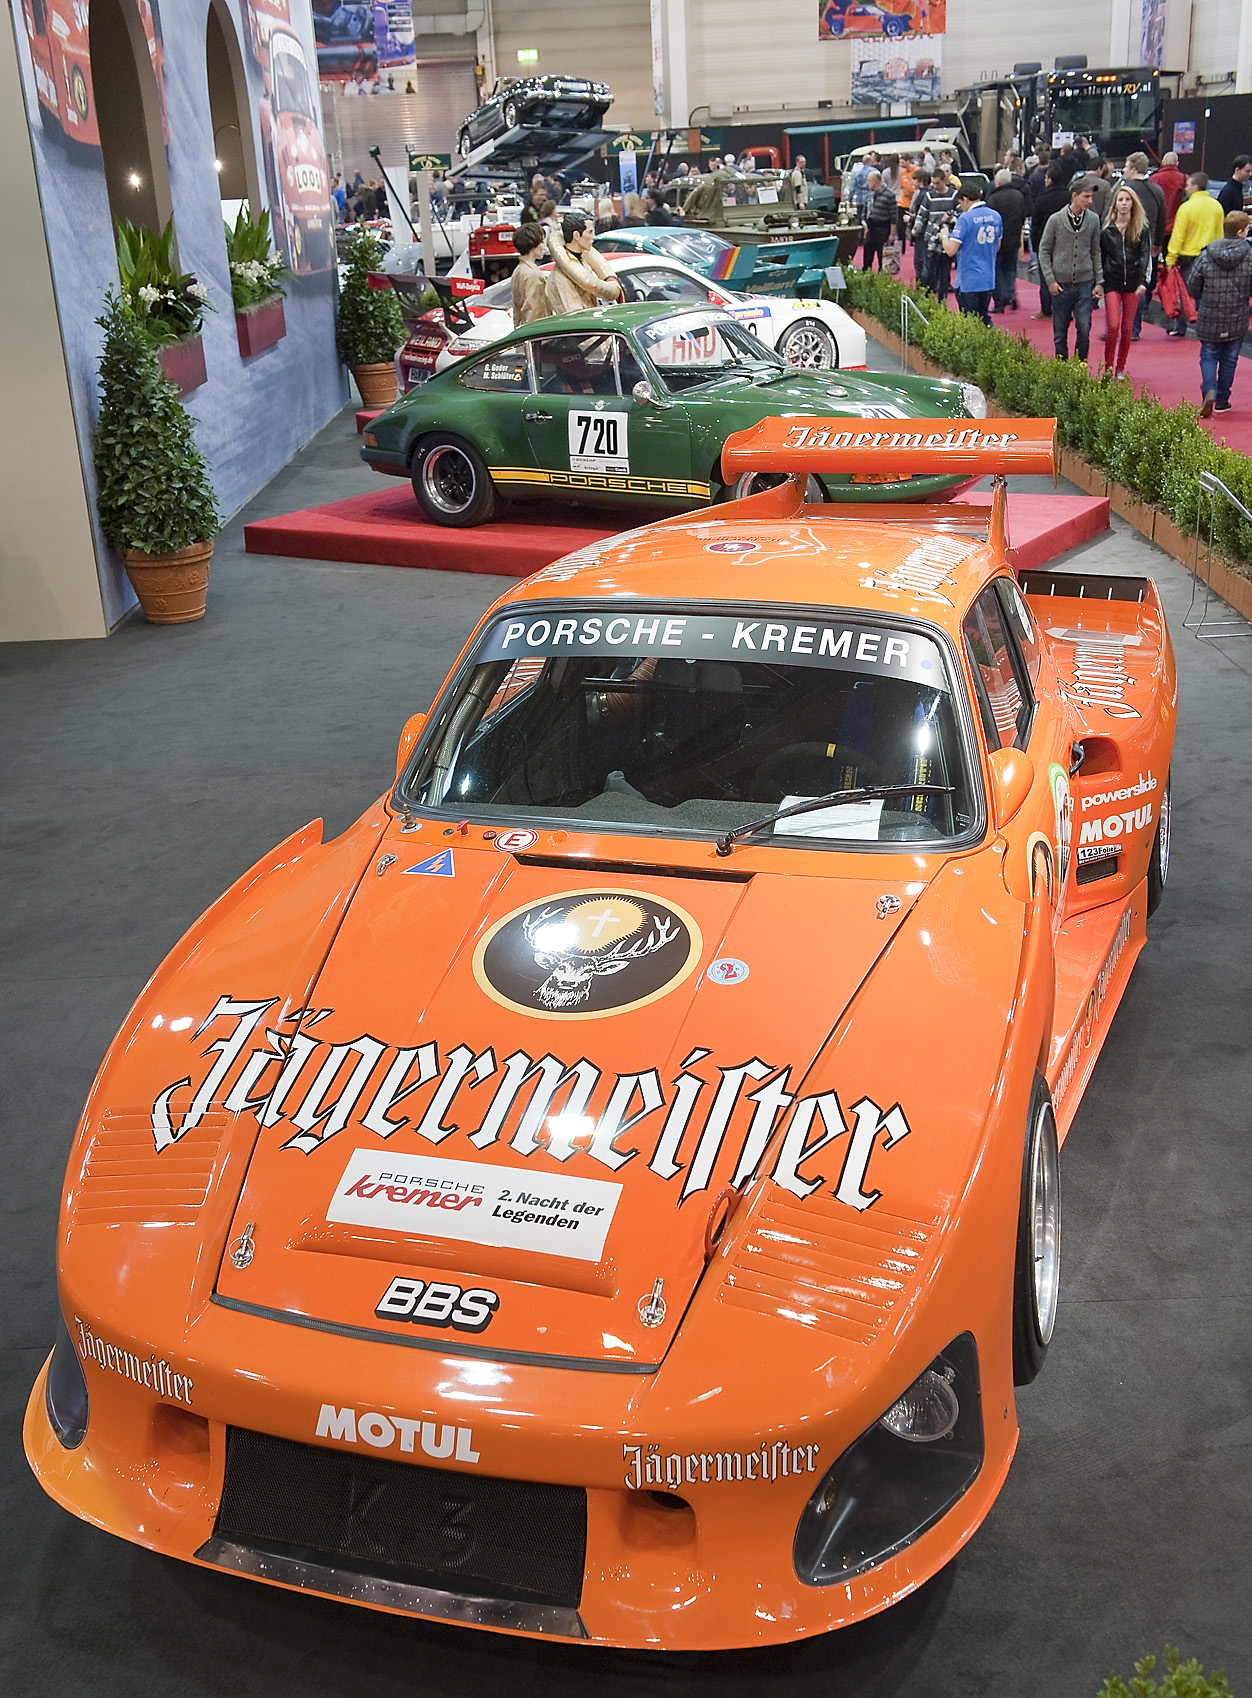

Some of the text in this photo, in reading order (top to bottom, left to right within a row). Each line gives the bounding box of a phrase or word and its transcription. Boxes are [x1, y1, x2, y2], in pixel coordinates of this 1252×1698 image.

[297, 171, 320, 193] LOOS
[977, 225, 995, 244] 63
[409, 334, 442, 349] WEILAND
[577, 416, 618, 455] 720
[781, 425, 1018, 450] Jägermeister
[550, 473, 689, 494] PORSCHE
[501, 617, 687, 650] PORSCHE
[731, 621, 911, 668] KREMER
[1081, 769, 1158, 812] powerslide
[1079, 802, 1153, 846] MOTUL
[720, 962, 738, 979] 2
[154, 995, 912, 1213] Jägermeister
[344, 1174, 483, 1212] kremer
[379, 1172, 485, 1194] PORSCHE
[492, 1205, 580, 1230] Legenden
[498, 1189, 605, 1217] 2. Nacht der
[376, 1276, 500, 1333] BBS
[74, 1315, 194, 1405] Jägermeister
[315, 1404, 480, 1463] MOTUL
[622, 1440, 821, 1489] Jägermeister
